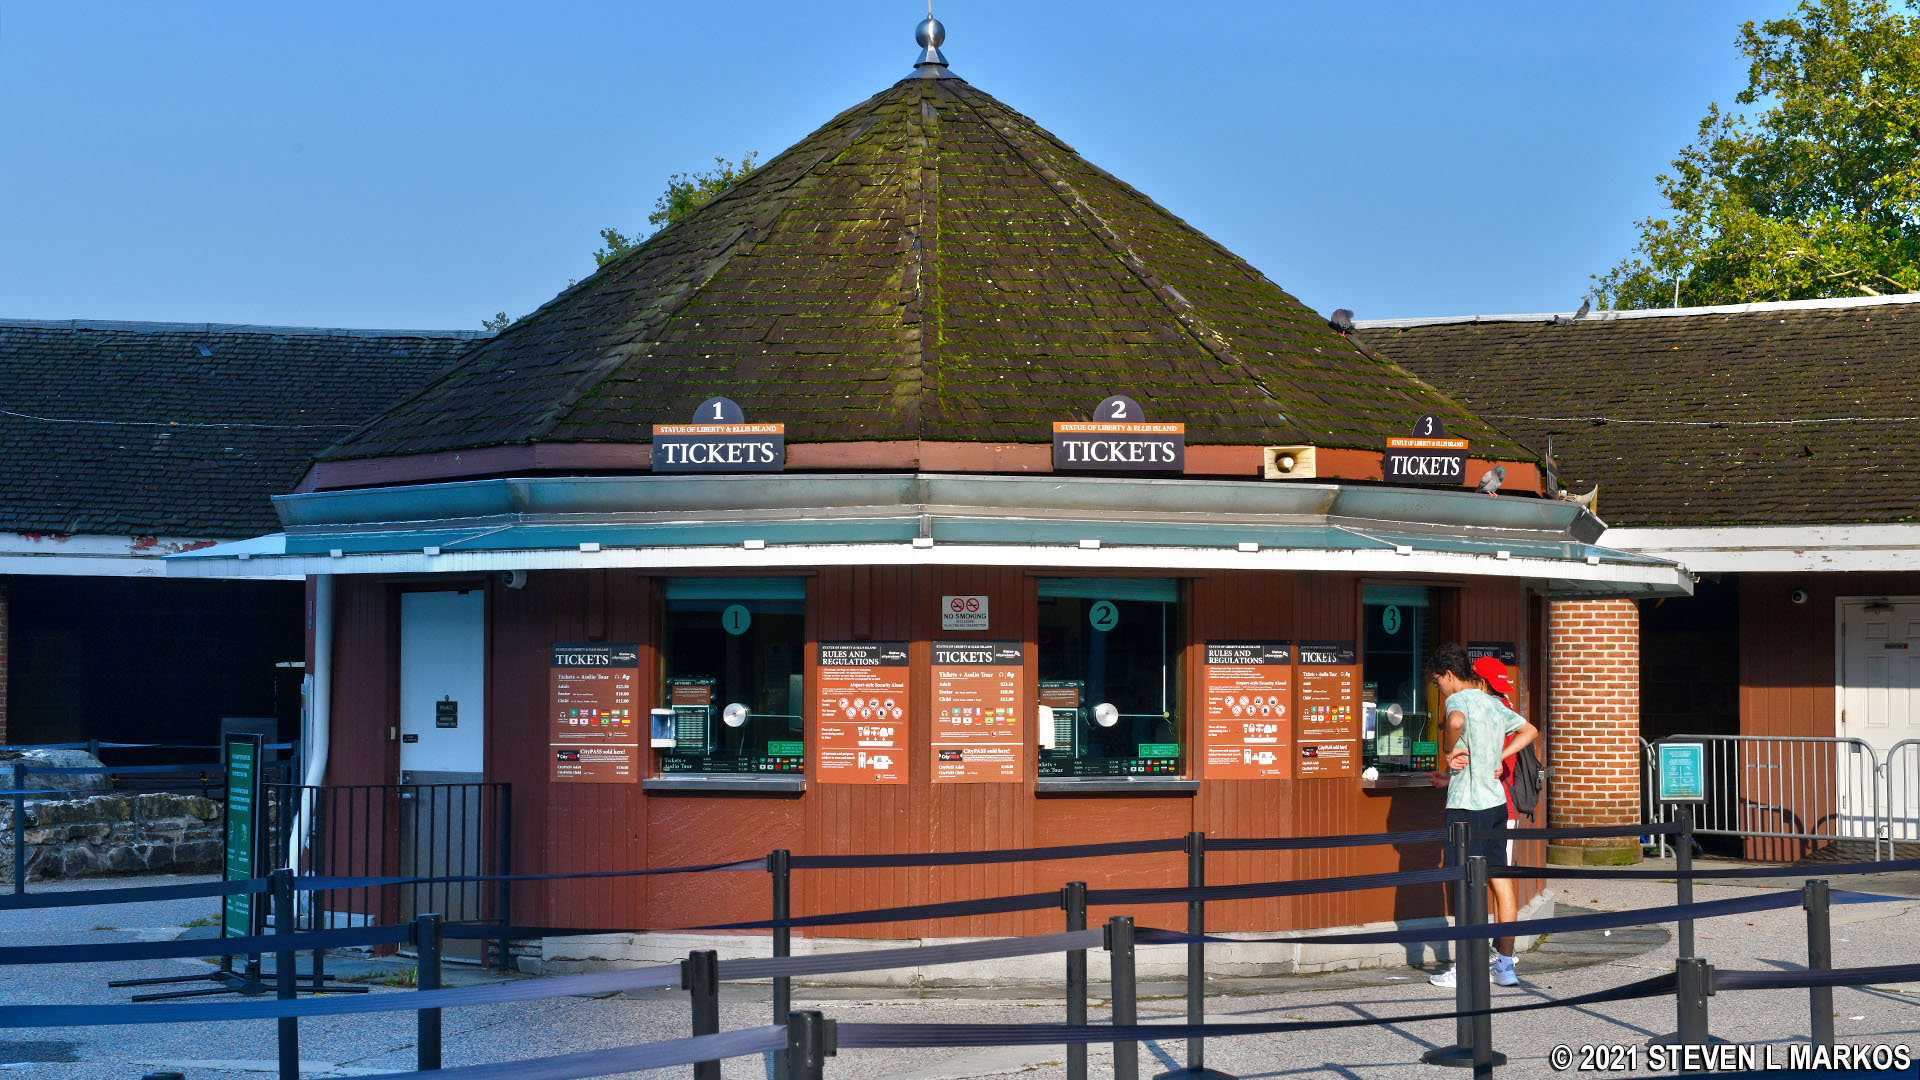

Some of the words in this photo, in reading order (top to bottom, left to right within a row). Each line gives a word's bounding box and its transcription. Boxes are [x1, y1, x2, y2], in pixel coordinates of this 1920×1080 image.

[712, 402, 724, 420] 1
[1112, 400, 1126, 418] 2
[1424, 416, 1433, 435] 3
[662, 443, 774, 463] TICKETS
[1063, 441, 1176, 462] TICKETS
[1391, 456, 1460, 475] TICKETS
[732, 610, 741, 629] 1
[1096, 606, 1112, 624] 2
[1388, 608, 1396, 630] 3
[556, 654, 609, 665] TICKETS
[936, 652, 992, 662] TICKETS
[1301, 652, 1337, 662] TICKETS
